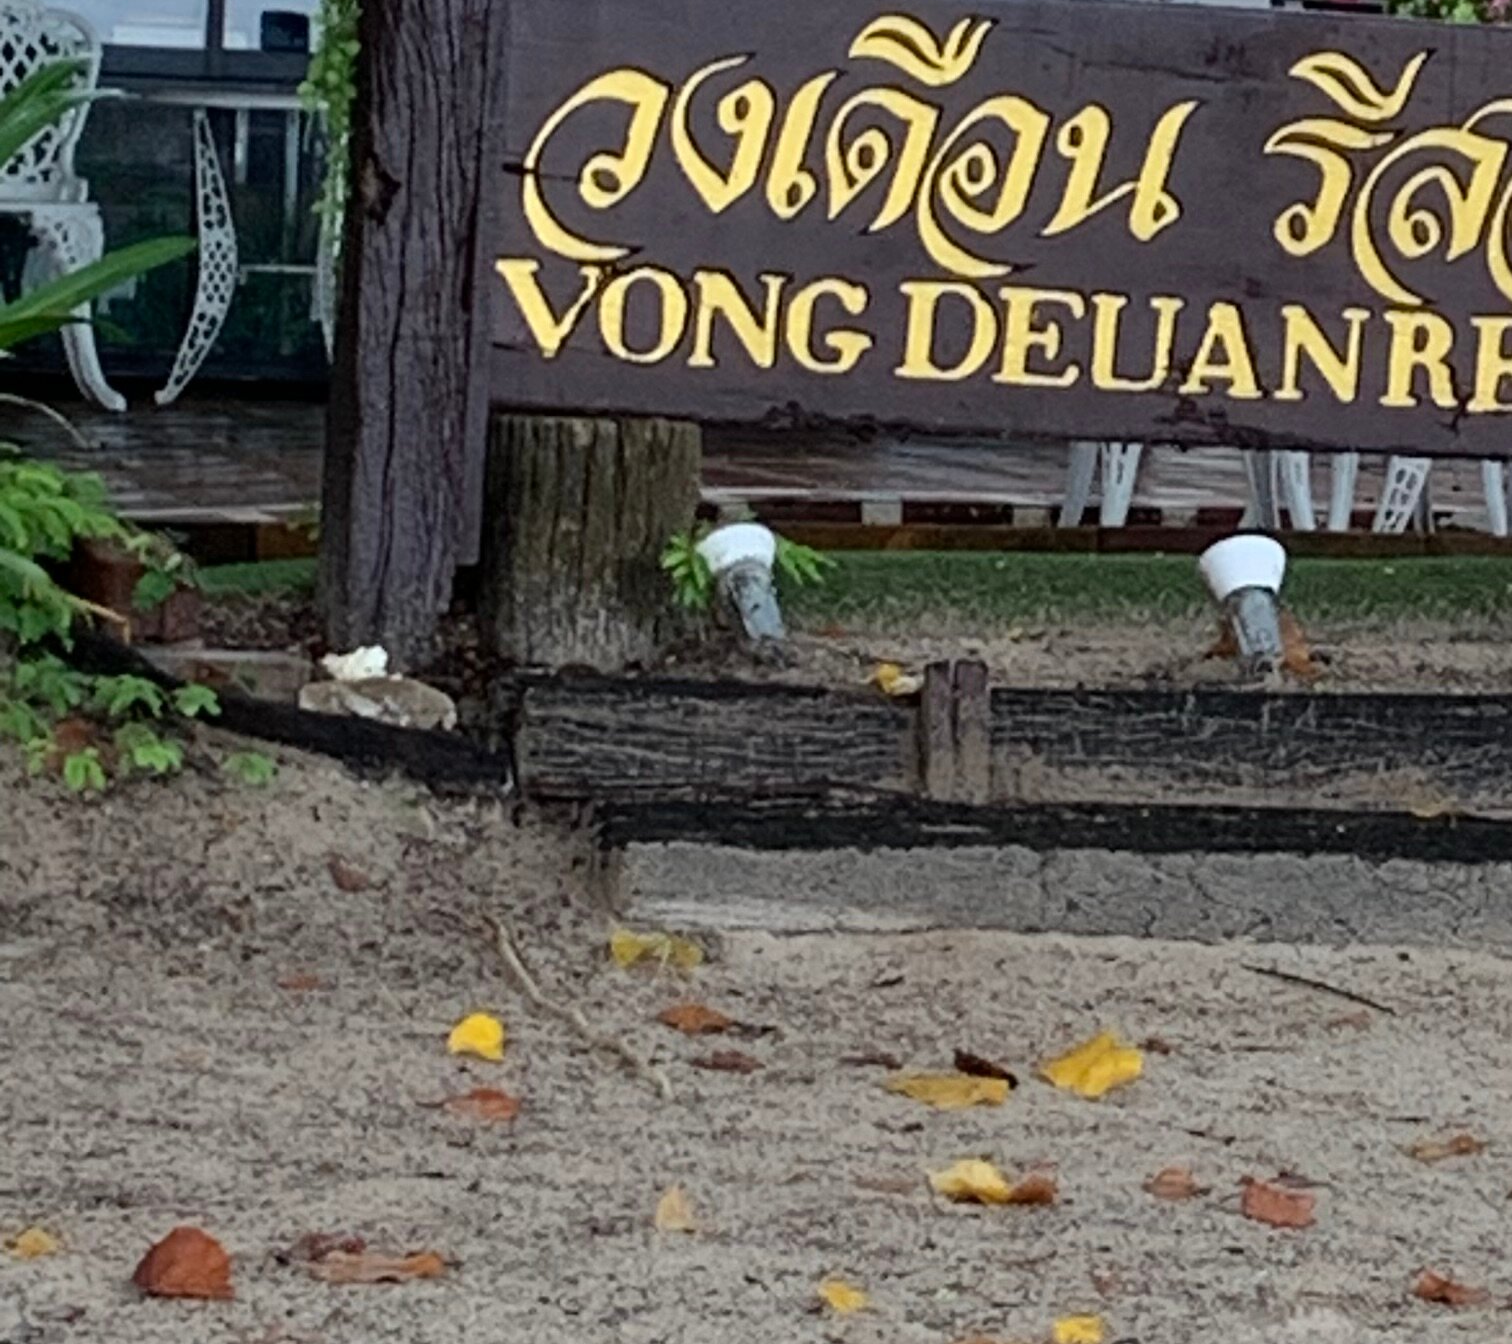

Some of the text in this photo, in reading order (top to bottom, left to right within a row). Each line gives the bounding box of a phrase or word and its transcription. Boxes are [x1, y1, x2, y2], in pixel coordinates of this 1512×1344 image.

[521, 14, 1196, 280] วงเดือน
[494, 258, 870, 372] VONG
[896, 278, 1368, 402] DEUAN
